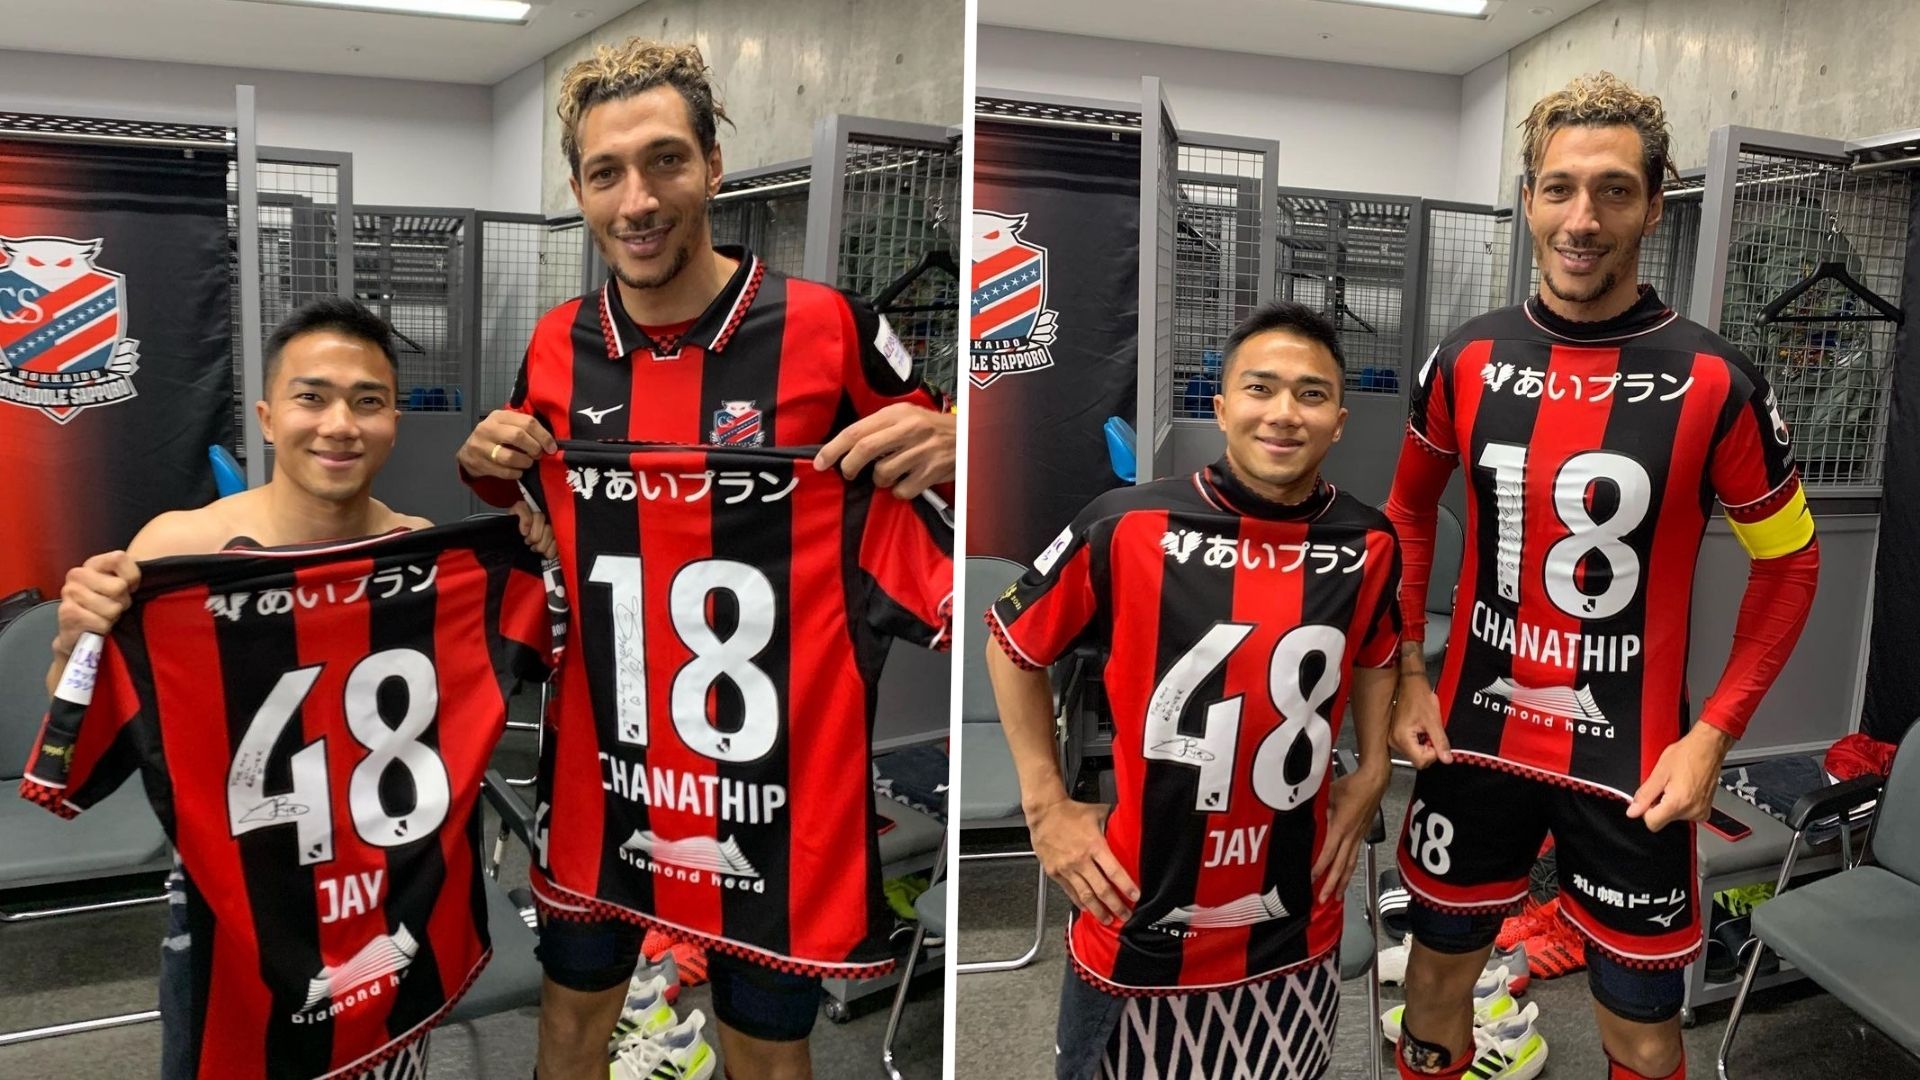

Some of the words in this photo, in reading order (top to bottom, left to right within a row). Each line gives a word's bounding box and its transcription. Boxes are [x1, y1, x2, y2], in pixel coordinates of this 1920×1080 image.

[970, 339, 1020, 350] KAIDO
[970, 355, 988, 371] LE
[992, 348, 1048, 371] SAPPORO
[1513, 367, 1694, 403] あいプラン
[603, 467, 800, 504] あいプラン
[1204, 533, 1368, 573] あいプラン
[1478, 442, 1652, 619] 18
[588, 555, 779, 762] 18
[1472, 600, 1640, 672] CHANATHIP
[1144, 623, 1346, 811] 48
[1472, 692, 1553, 728] Diamond
[1565, 720, 1615, 739] head
[228, 648, 450, 866] 48
[1204, 824, 1269, 868] JAY
[1409, 798, 1454, 875] 48
[619, 847, 700, 883] Diamond
[711, 872, 765, 894] head
[1573, 873, 1686, 909] 札幌ドーム
[319, 869, 384, 923] JAY
[1148, 925, 1198, 938] Diam
[291, 980, 381, 1024] Diamond
